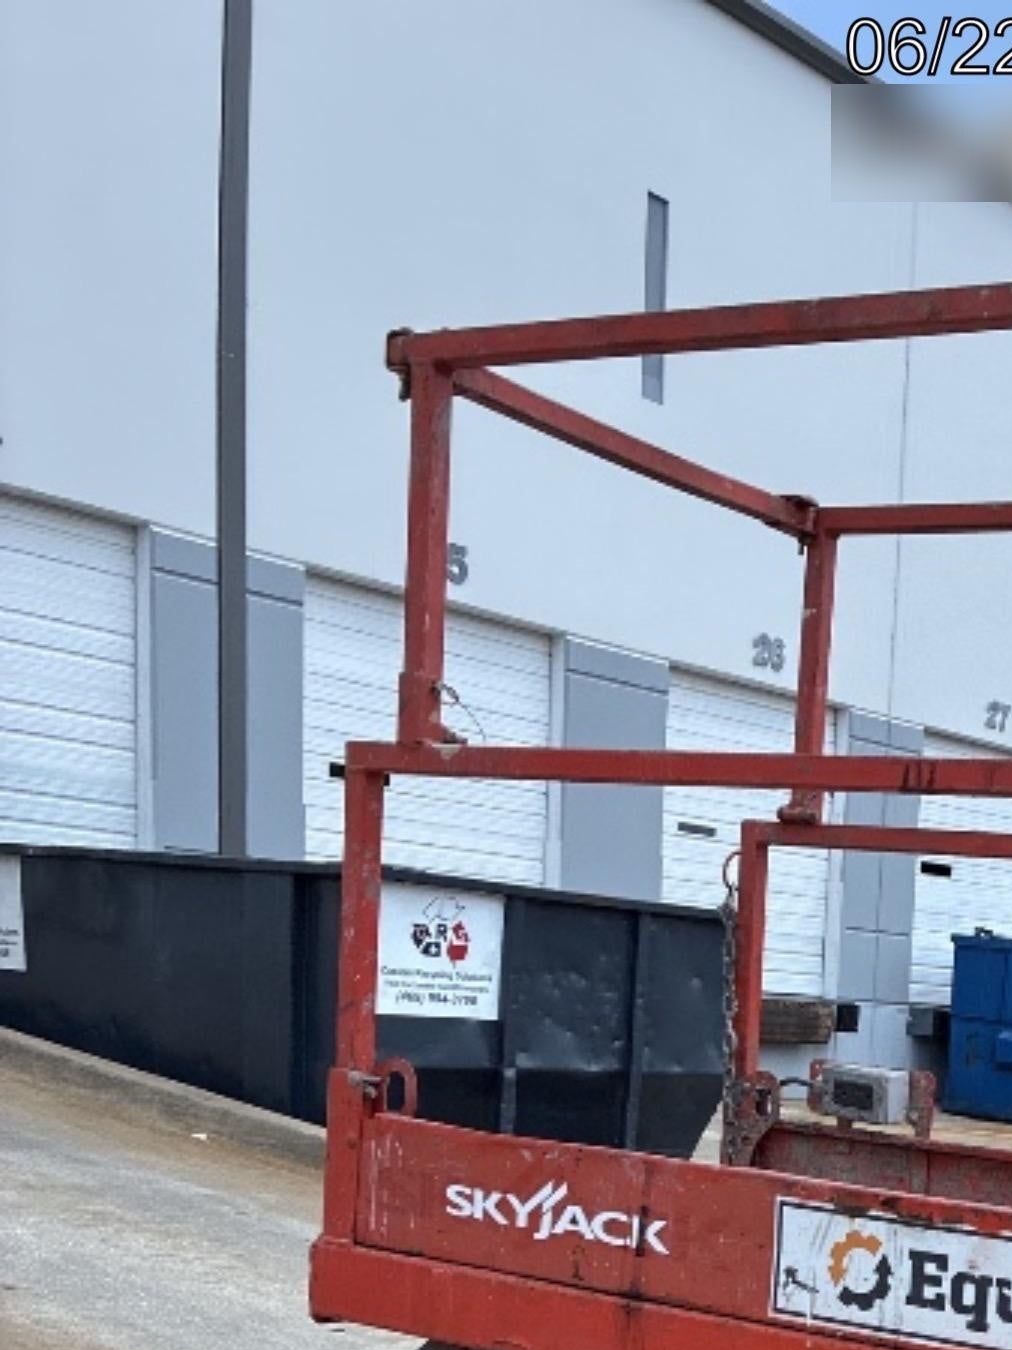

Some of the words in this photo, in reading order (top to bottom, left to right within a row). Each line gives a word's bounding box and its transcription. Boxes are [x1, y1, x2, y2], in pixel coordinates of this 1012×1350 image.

[447, 543, 469, 586] 5
[985, 700, 1012, 732] 27
[445, 1180, 670, 1255] SKYJACK
